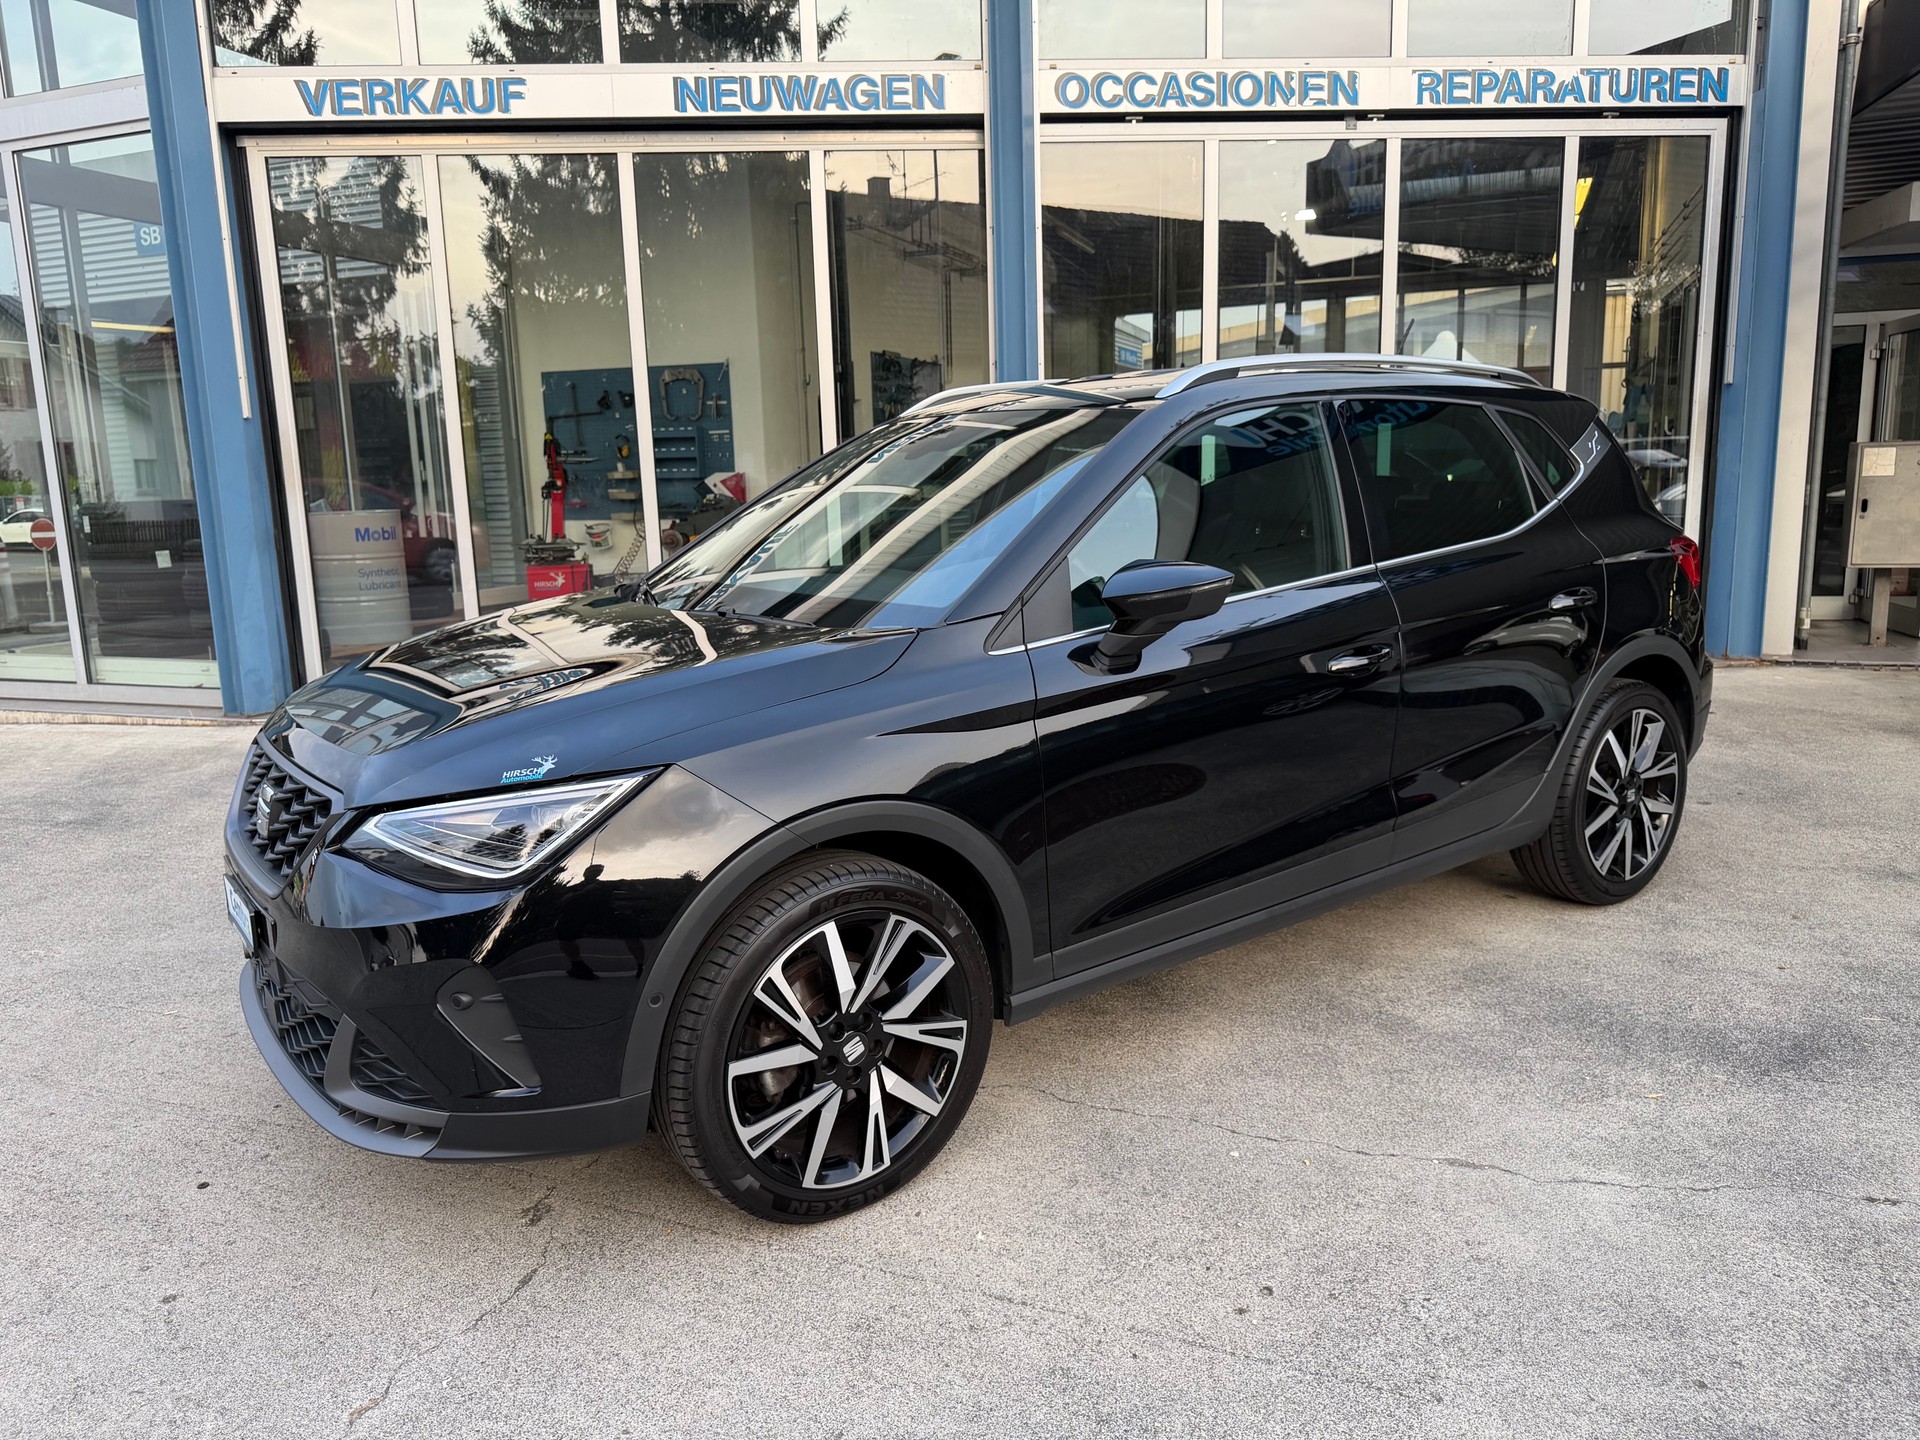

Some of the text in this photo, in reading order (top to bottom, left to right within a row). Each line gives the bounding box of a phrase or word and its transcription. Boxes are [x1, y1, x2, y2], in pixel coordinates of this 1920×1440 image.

[672, 73, 947, 113] NEUWAGEN
[1054, 69, 1361, 109] OCCASIONEN
[1411, 66, 1731, 106] REPARATUREN
[293, 77, 528, 117] VERKAUF
[139, 226, 161, 246] SB
[354, 526, 397, 543] Mobil
[357, 567, 401, 580] Synthetic
[500, 773, 544, 784] Automobile
[502, 767, 542, 779] HIRSCH
[890, 890, 928, 907] Sport
[786, 1183, 886, 1216] NEXEN
